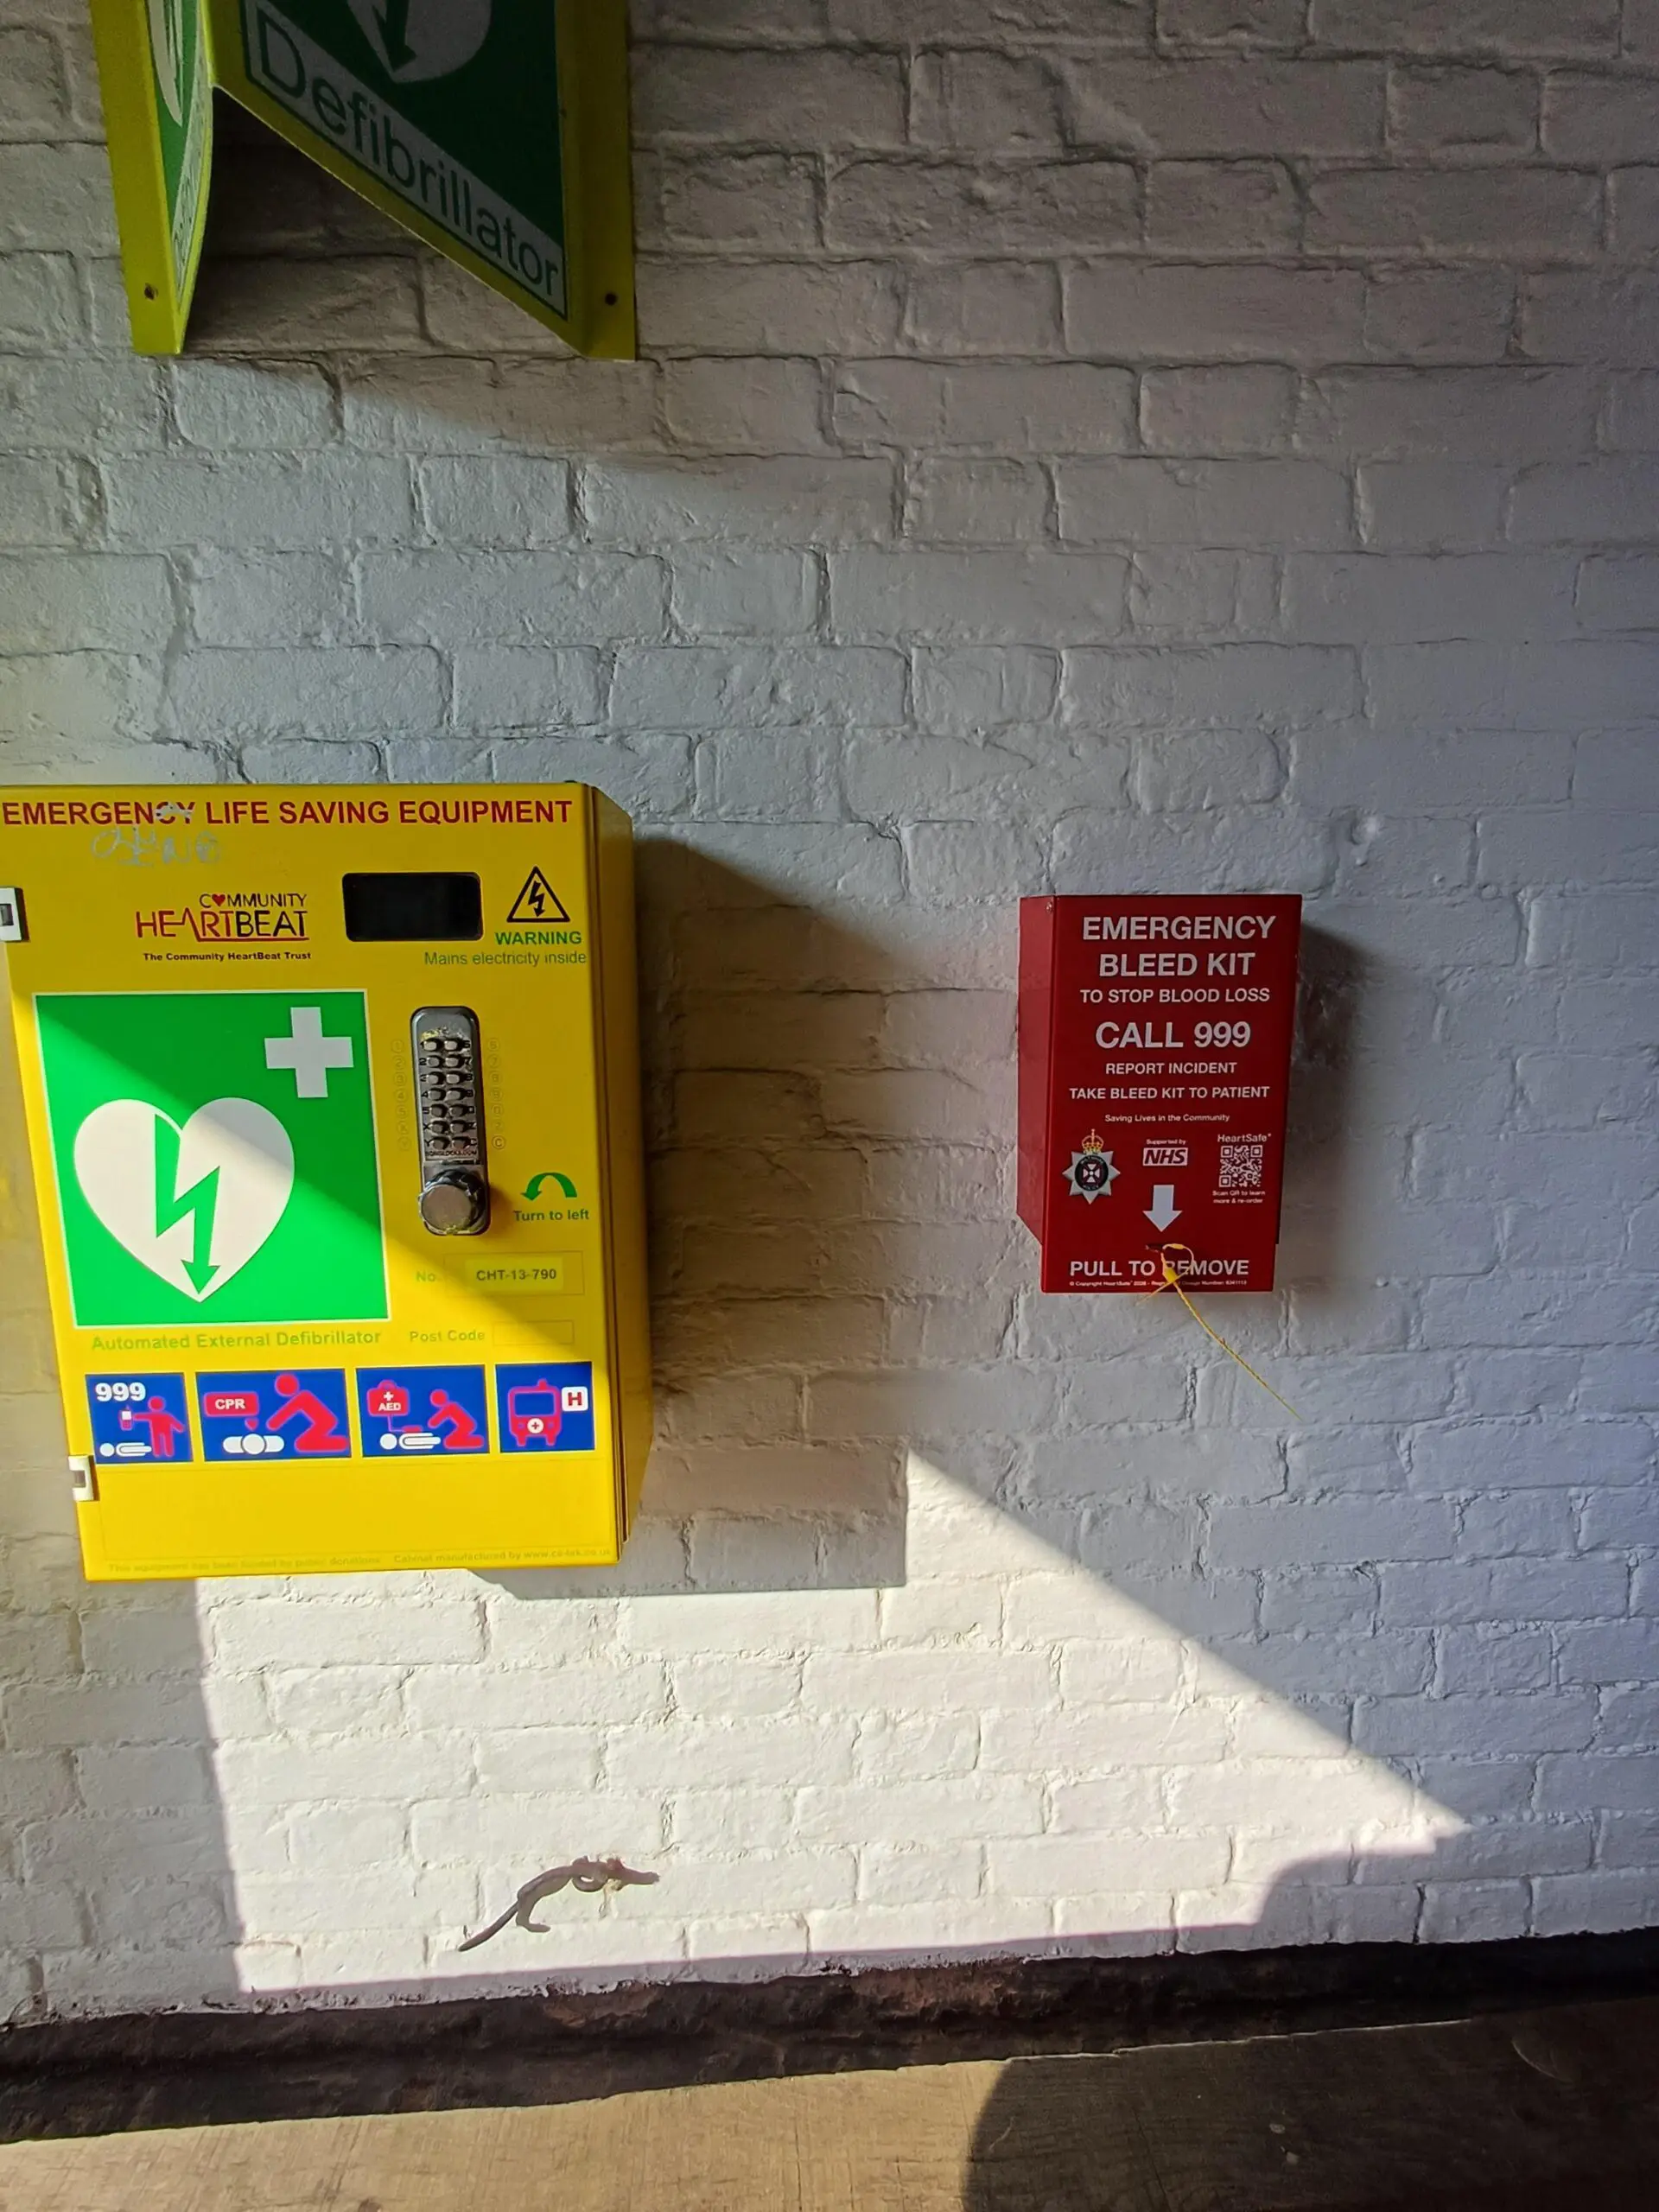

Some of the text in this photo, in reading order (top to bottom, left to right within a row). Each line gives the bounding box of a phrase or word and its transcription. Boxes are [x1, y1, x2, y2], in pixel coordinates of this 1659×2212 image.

[261, 12, 559, 297] Defibrillator
[3, 800, 573, 825] EMERGENCY LIFE SAVING EQUIPMENT
[136, 907, 309, 943] HEARTBEAT
[1083, 915, 1276, 940] EMERGENCY
[495, 931, 582, 945] WARNING
[143, 951, 311, 963] The Community HeartBeat Trust
[424, 950, 587, 967] Mains electricity inside
[1099, 952, 1255, 976] BLEED KIT
[1080, 987, 1270, 1003] TO STOP BLOOD LOSS
[1096, 1020, 1251, 1049] CALL 999
[1105, 1061, 1237, 1075] REPORT INCIDENT
[1069, 1085, 1269, 1099] TAKE BLEED KIT TO PATIENT
[1104, 1114, 1133, 1123] Saving
[1135, 1114, 1156, 1122] Lives
[1183, 1113, 1230, 1122] Community
[1144, 1149, 1187, 1165] NHS
[514, 1208, 589, 1222] Turn to left
[476, 1268, 557, 1281] CHT-13-790
[1070, 1260, 1122, 1276] PULL
[1128, 1260, 1155, 1276] TO
[92, 1330, 381, 1351] Automated External Defibrillator
[410, 1329, 485, 1343] Post Code
[95, 1382, 146, 1402] 999
[568, 1392, 582, 1406] H
[215, 1398, 245, 1410] CPR
[378, 1402, 401, 1411] AED
[394, 1554, 432, 1563] Cabinet
[435, 1551, 505, 1561] manufactured
[509, 1550, 521, 1561] by
